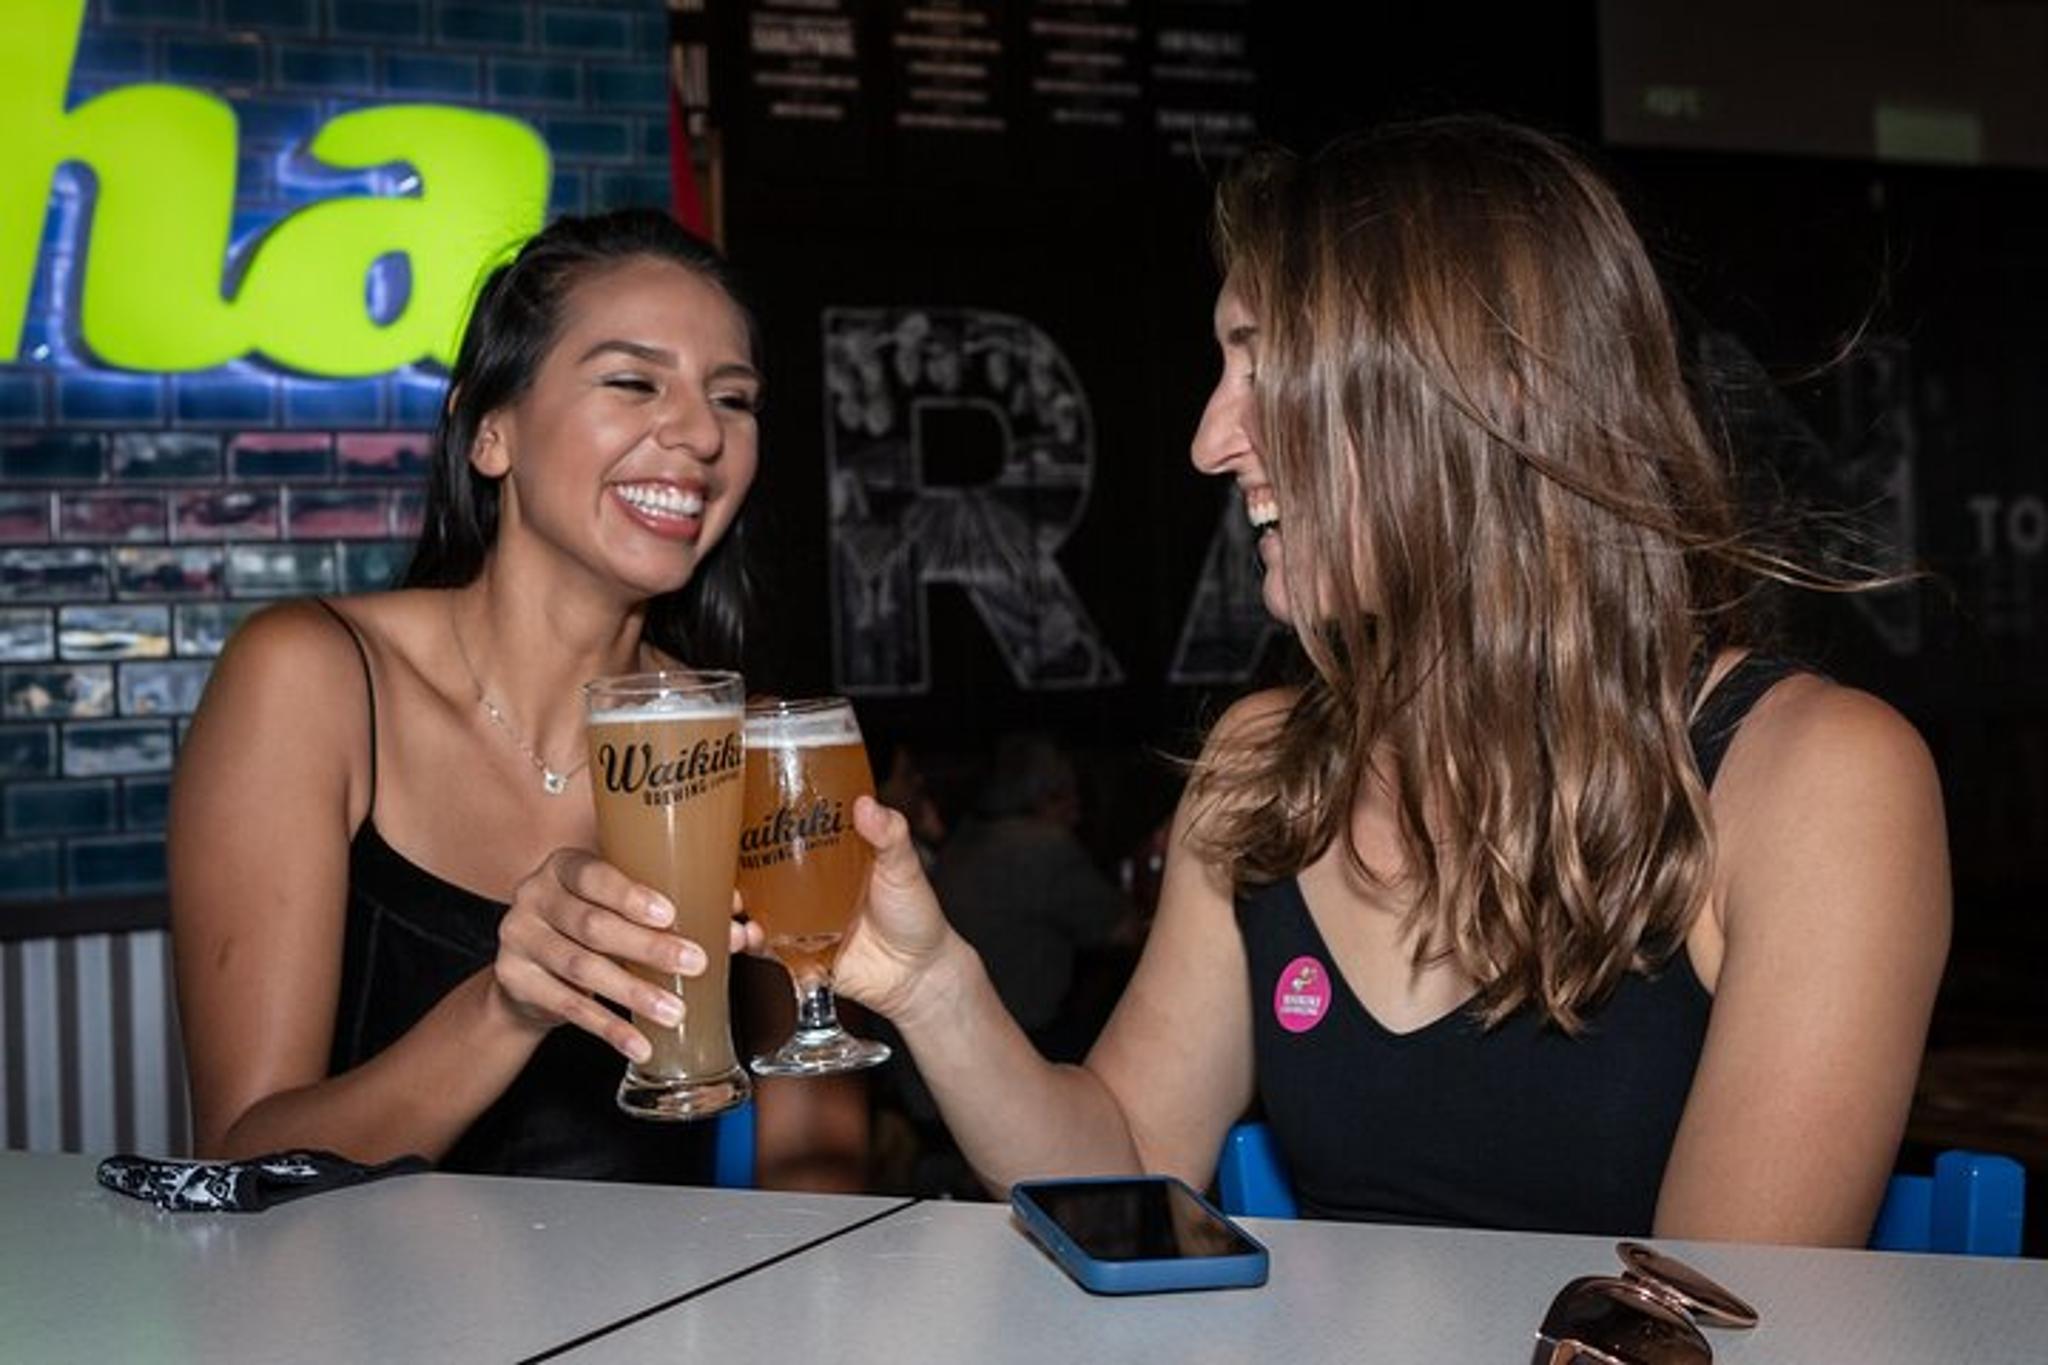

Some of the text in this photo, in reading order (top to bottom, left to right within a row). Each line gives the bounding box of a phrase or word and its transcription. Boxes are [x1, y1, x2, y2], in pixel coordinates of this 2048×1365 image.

[1964, 492, 2048, 557] TO
[598, 731, 741, 793] Waikiki
[740, 798, 842, 851] aikiki
